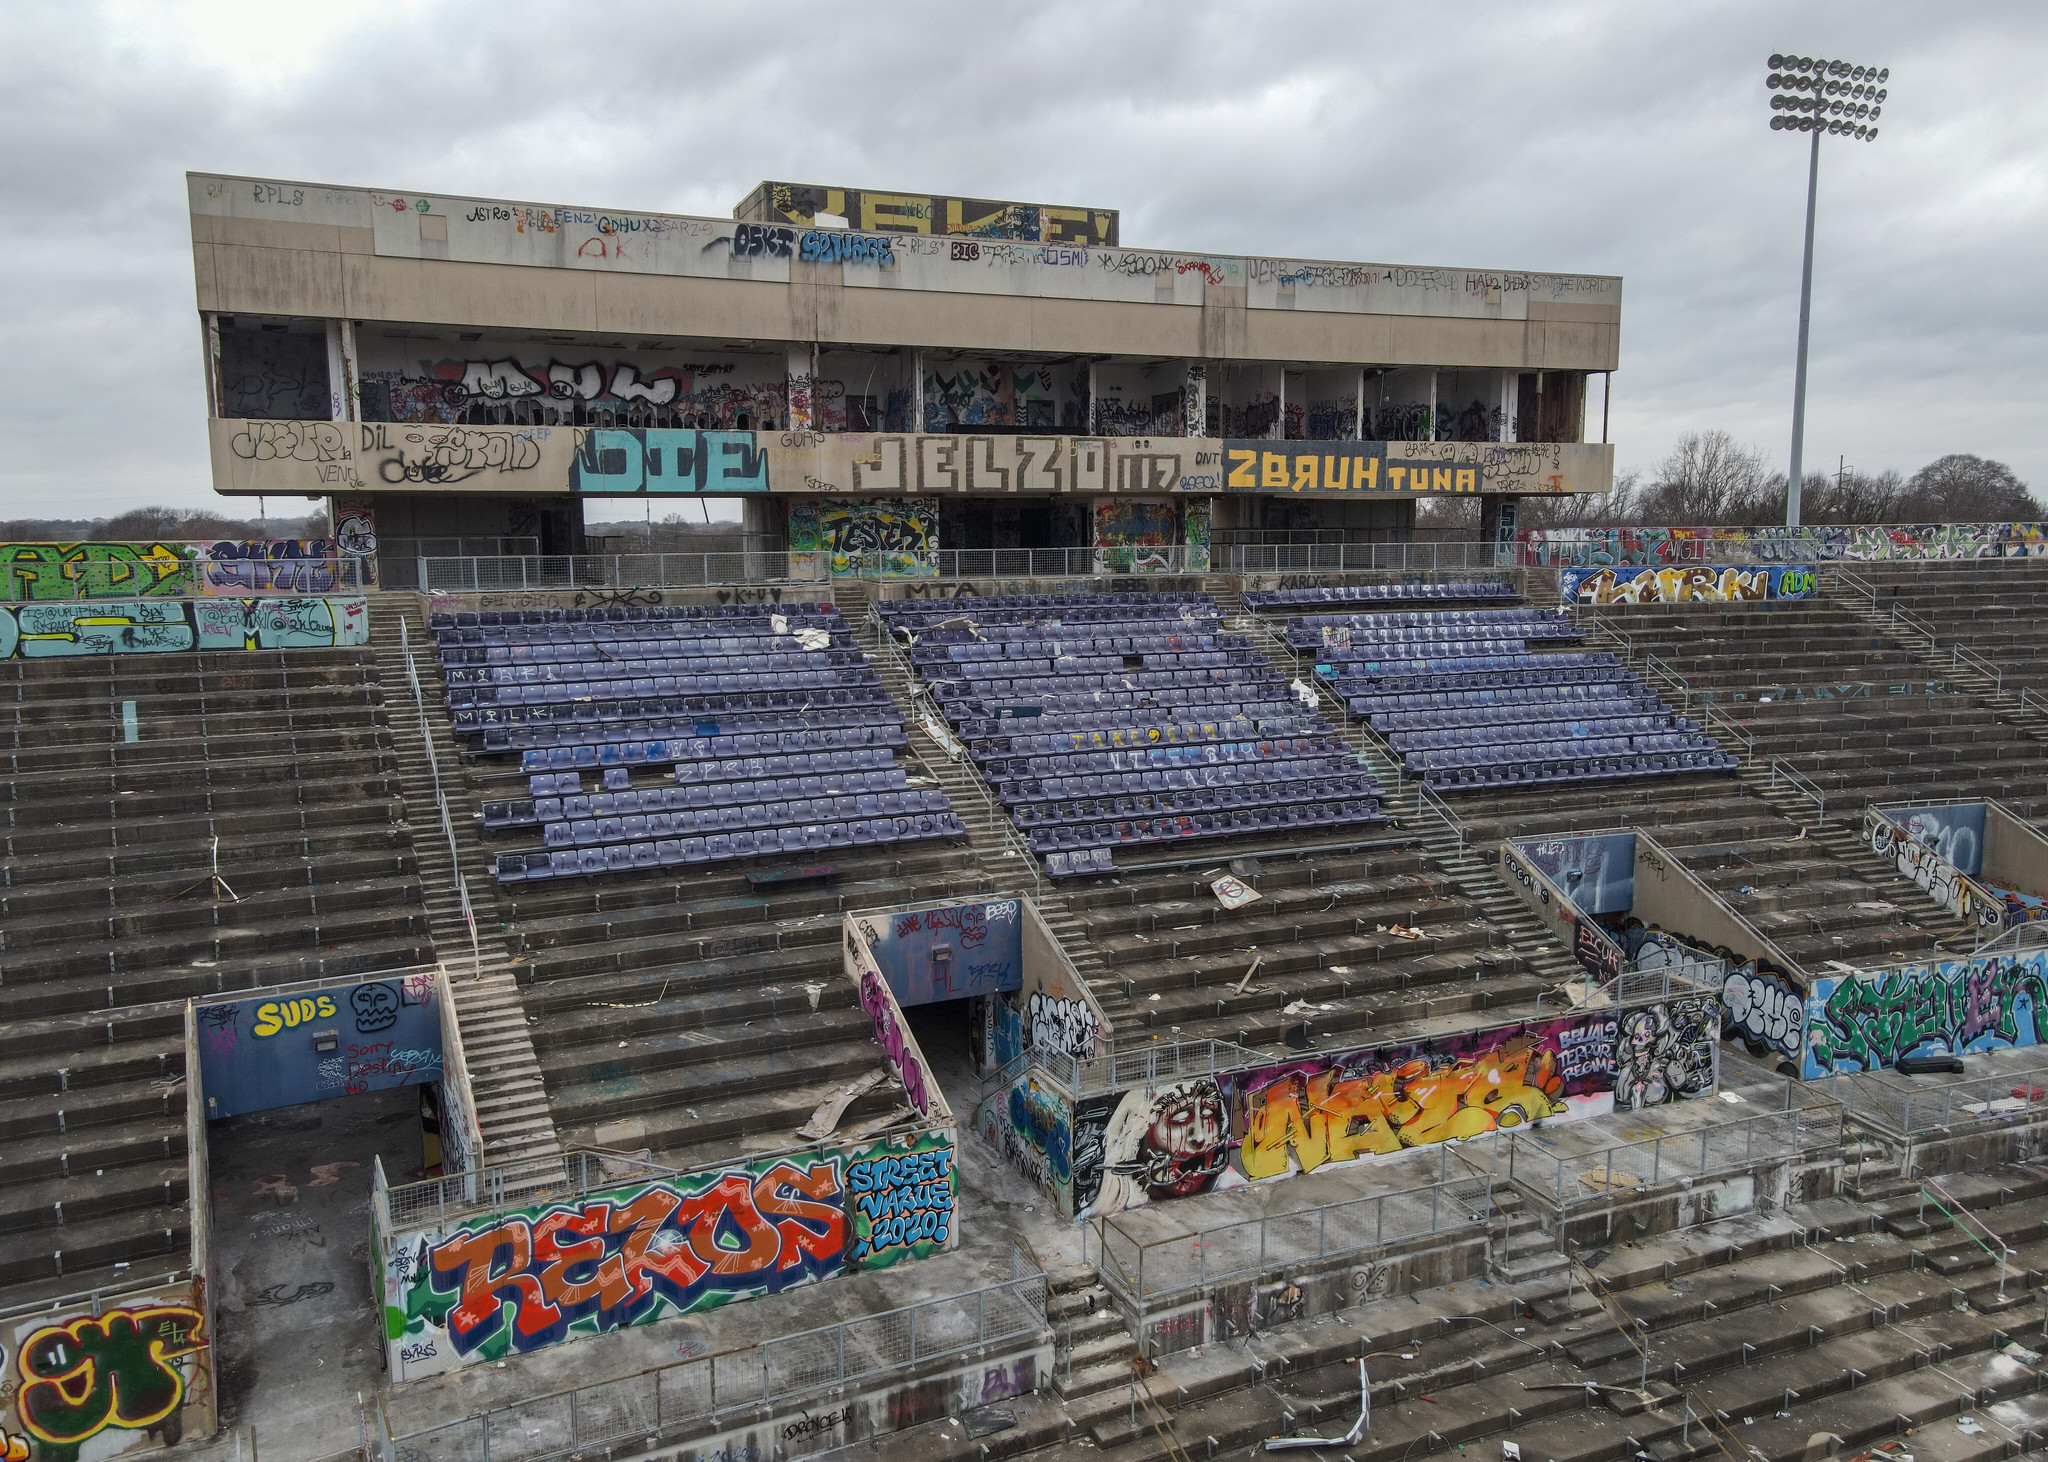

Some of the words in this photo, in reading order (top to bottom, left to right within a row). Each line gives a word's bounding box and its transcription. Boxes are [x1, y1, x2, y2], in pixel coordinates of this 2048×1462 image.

[254, 184, 304, 206] RPLS
[781, 431, 825, 449] GUAP
[1388, 467, 1476, 492] TUNA
[904, 581, 980, 600] MTA
[1781, 570, 1816, 593] ADM
[252, 995, 338, 1039] SUDS
[1557, 1043, 1611, 1068] TERROR
[1561, 1060, 1621, 1083] REGIME
[849, 1148, 954, 1191] STREET
